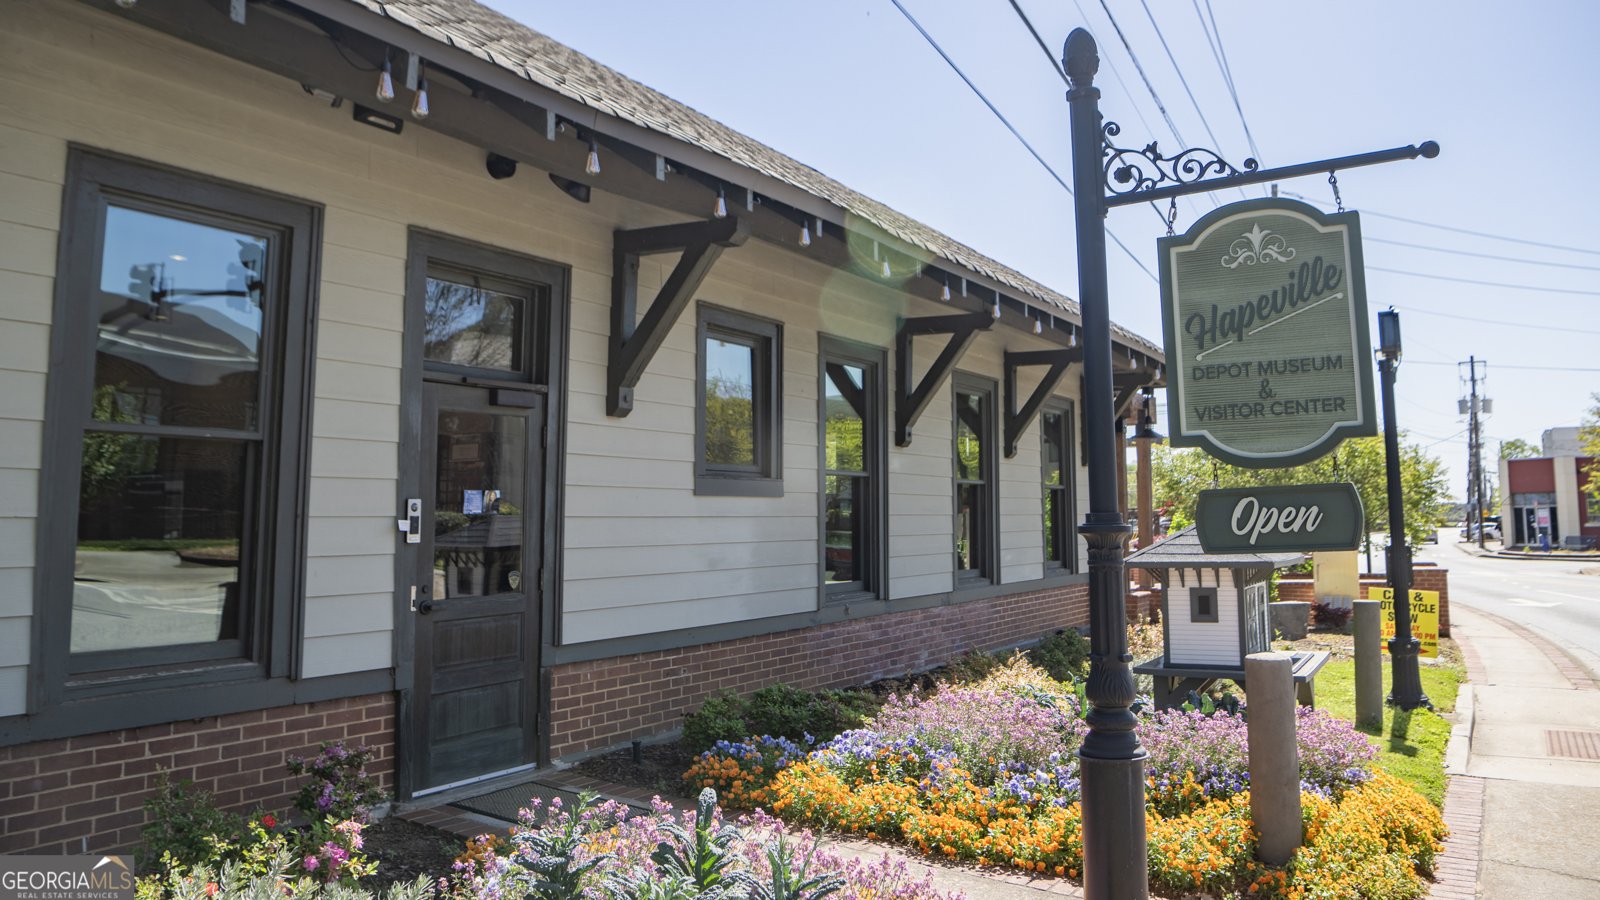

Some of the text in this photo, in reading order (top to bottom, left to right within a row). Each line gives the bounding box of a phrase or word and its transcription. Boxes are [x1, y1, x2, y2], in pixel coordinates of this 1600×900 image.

[1185, 256, 1343, 349] Hapeville
[1192, 355, 1343, 381] DEPOT MUSEUM
[1259, 378, 1276, 399] &
[1195, 397, 1346, 421] VISITOR CENTER
[1231, 496, 1323, 545] Open
[1414, 591, 1423, 602] &
